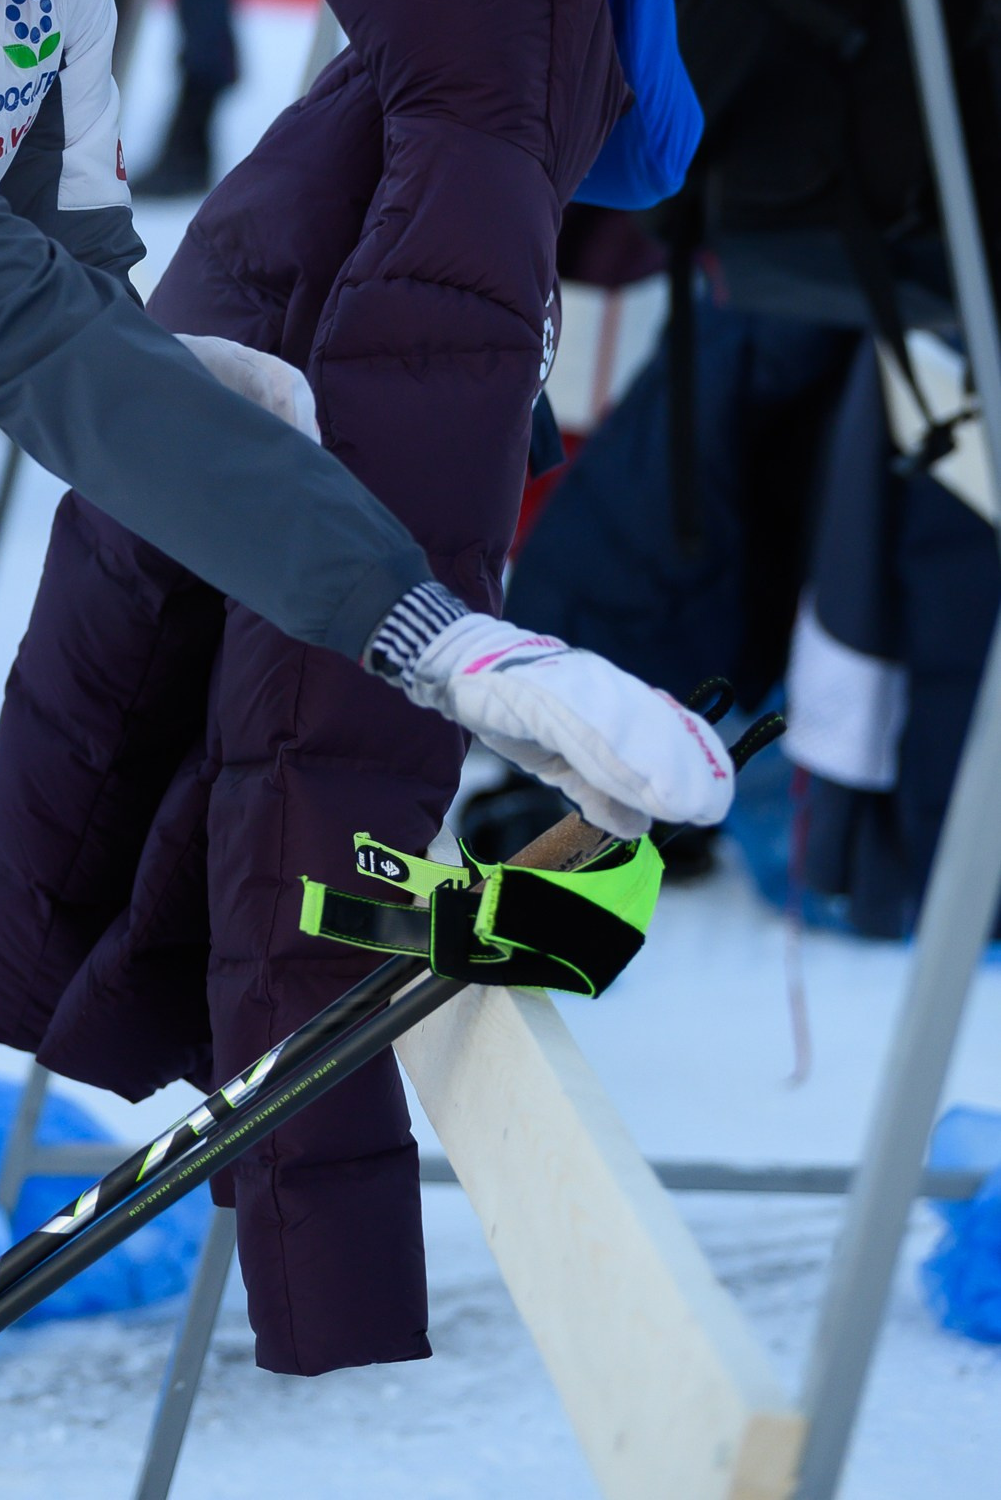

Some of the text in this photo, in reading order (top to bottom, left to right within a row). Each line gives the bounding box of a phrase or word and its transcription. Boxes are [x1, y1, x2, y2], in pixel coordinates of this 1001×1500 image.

[313, 1059, 338, 1079] SUPER
[291, 1077, 313, 1096] LIGHT
[255, 1094, 290, 1122] ULTIMATE
[224, 1121, 254, 1145] CARBON
[178, 1145, 224, 1180] TECHNOLOGY
